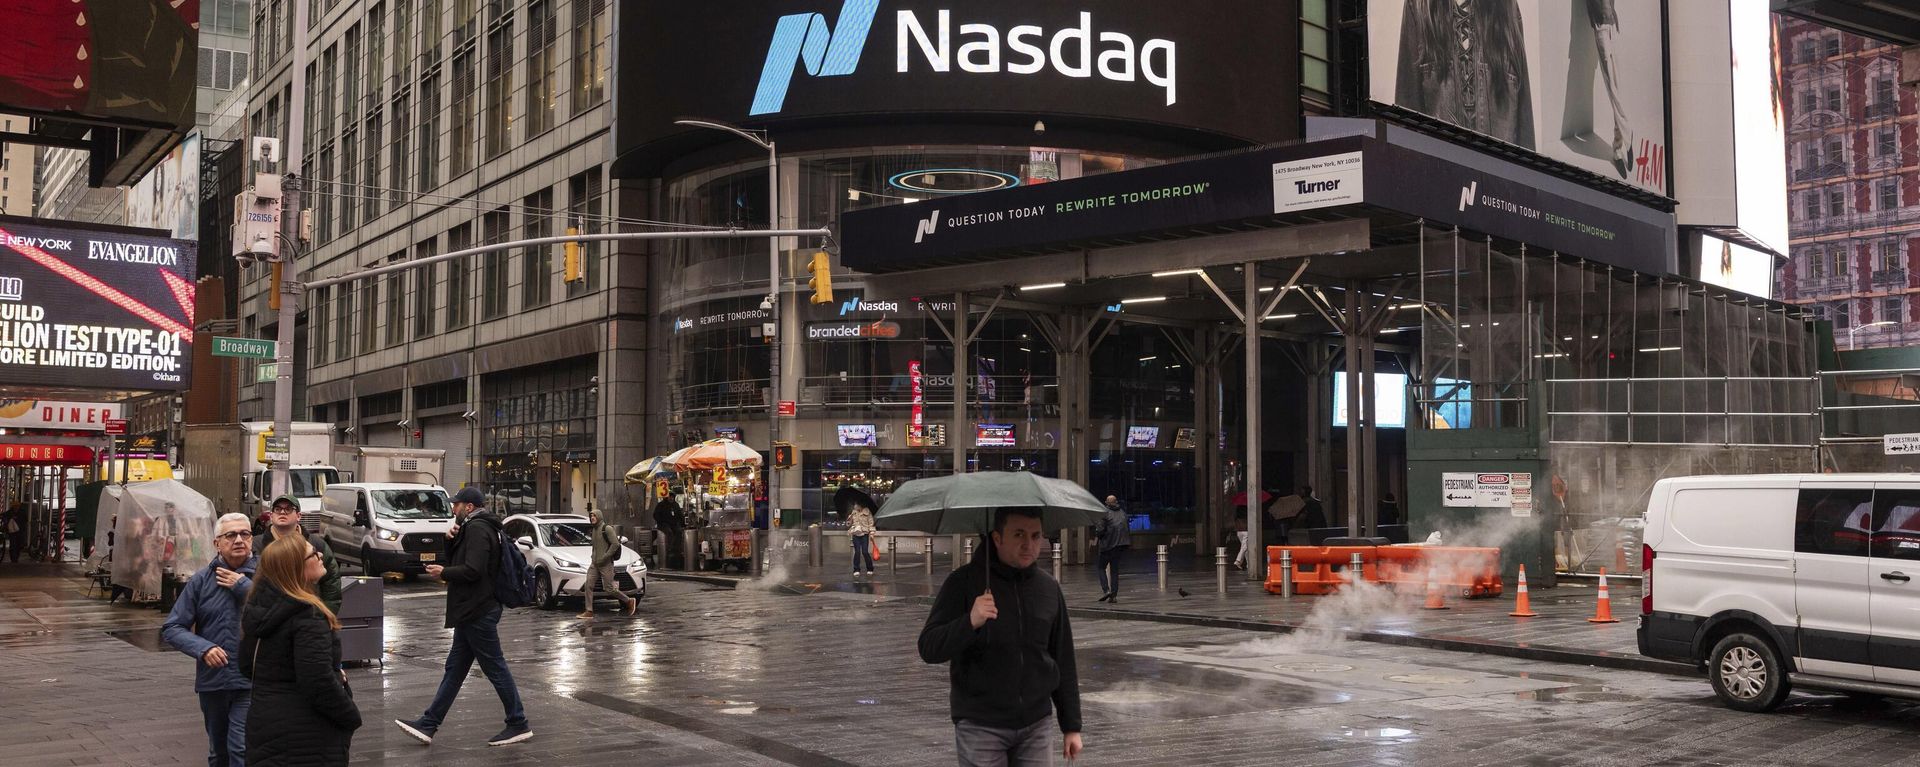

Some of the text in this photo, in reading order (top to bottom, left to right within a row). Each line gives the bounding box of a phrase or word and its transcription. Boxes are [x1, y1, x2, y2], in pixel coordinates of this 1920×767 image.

[896, 9, 1176, 107] Nasdaq
[1287, 165, 1311, 173] Broadway
[1636, 138, 1663, 192] H&M
[1295, 179, 1340, 195] Turner
[248, 212, 272, 223] 726156
[948, 211, 1003, 228] QUESTION
[1008, 205, 1046, 219] TODAY
[1056, 195, 1116, 213] REWRITE
[1482, 195, 1517, 213] QUESTION
[1519, 205, 1540, 220] TODAY
[1545, 213, 1575, 230] REWRITE
[8, 236, 35, 247] NEW
[38, 238, 72, 250] YORK
[88, 240, 177, 265] EVANGELION
[0, 304, 44, 321] UILD
[858, 301, 898, 313] Nasdaq
[0, 321, 181, 356] LION TEST TYPE-01
[220, 339, 268, 358] Broadway
[0, 347, 36, 365] ORE
[40, 350, 107, 368] LIMITED
[42, 407, 111, 423] DINER
[6, 447, 64, 459] DINER
[1445, 479, 1474, 489] PEDESTRIANS
